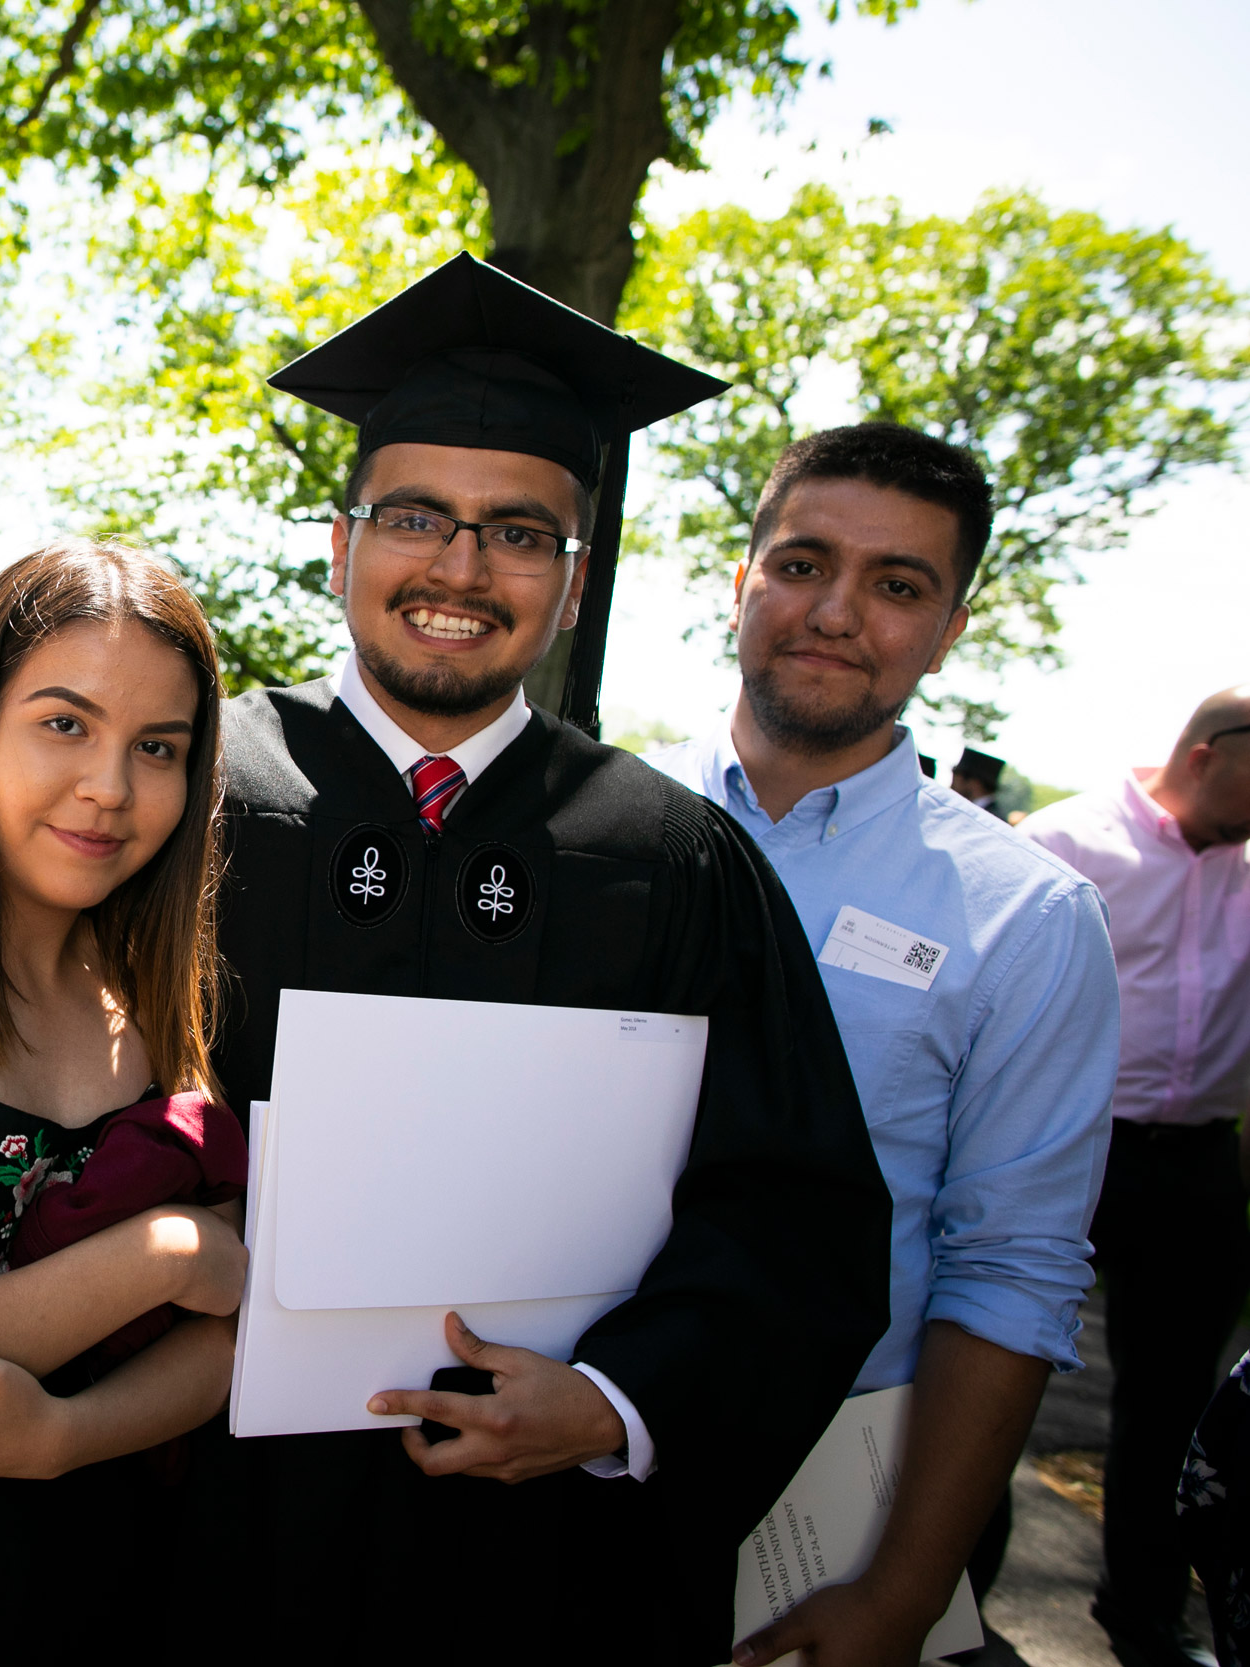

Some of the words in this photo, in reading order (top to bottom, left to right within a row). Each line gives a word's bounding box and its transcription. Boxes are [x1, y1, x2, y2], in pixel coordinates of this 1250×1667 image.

[765, 1511, 784, 1561] UNIVER
[804, 1514, 817, 1537] 2018
[810, 1537, 821, 1551] 24,
[813, 1554, 827, 1578] MAY
[777, 1562, 796, 1609] ARVARD
